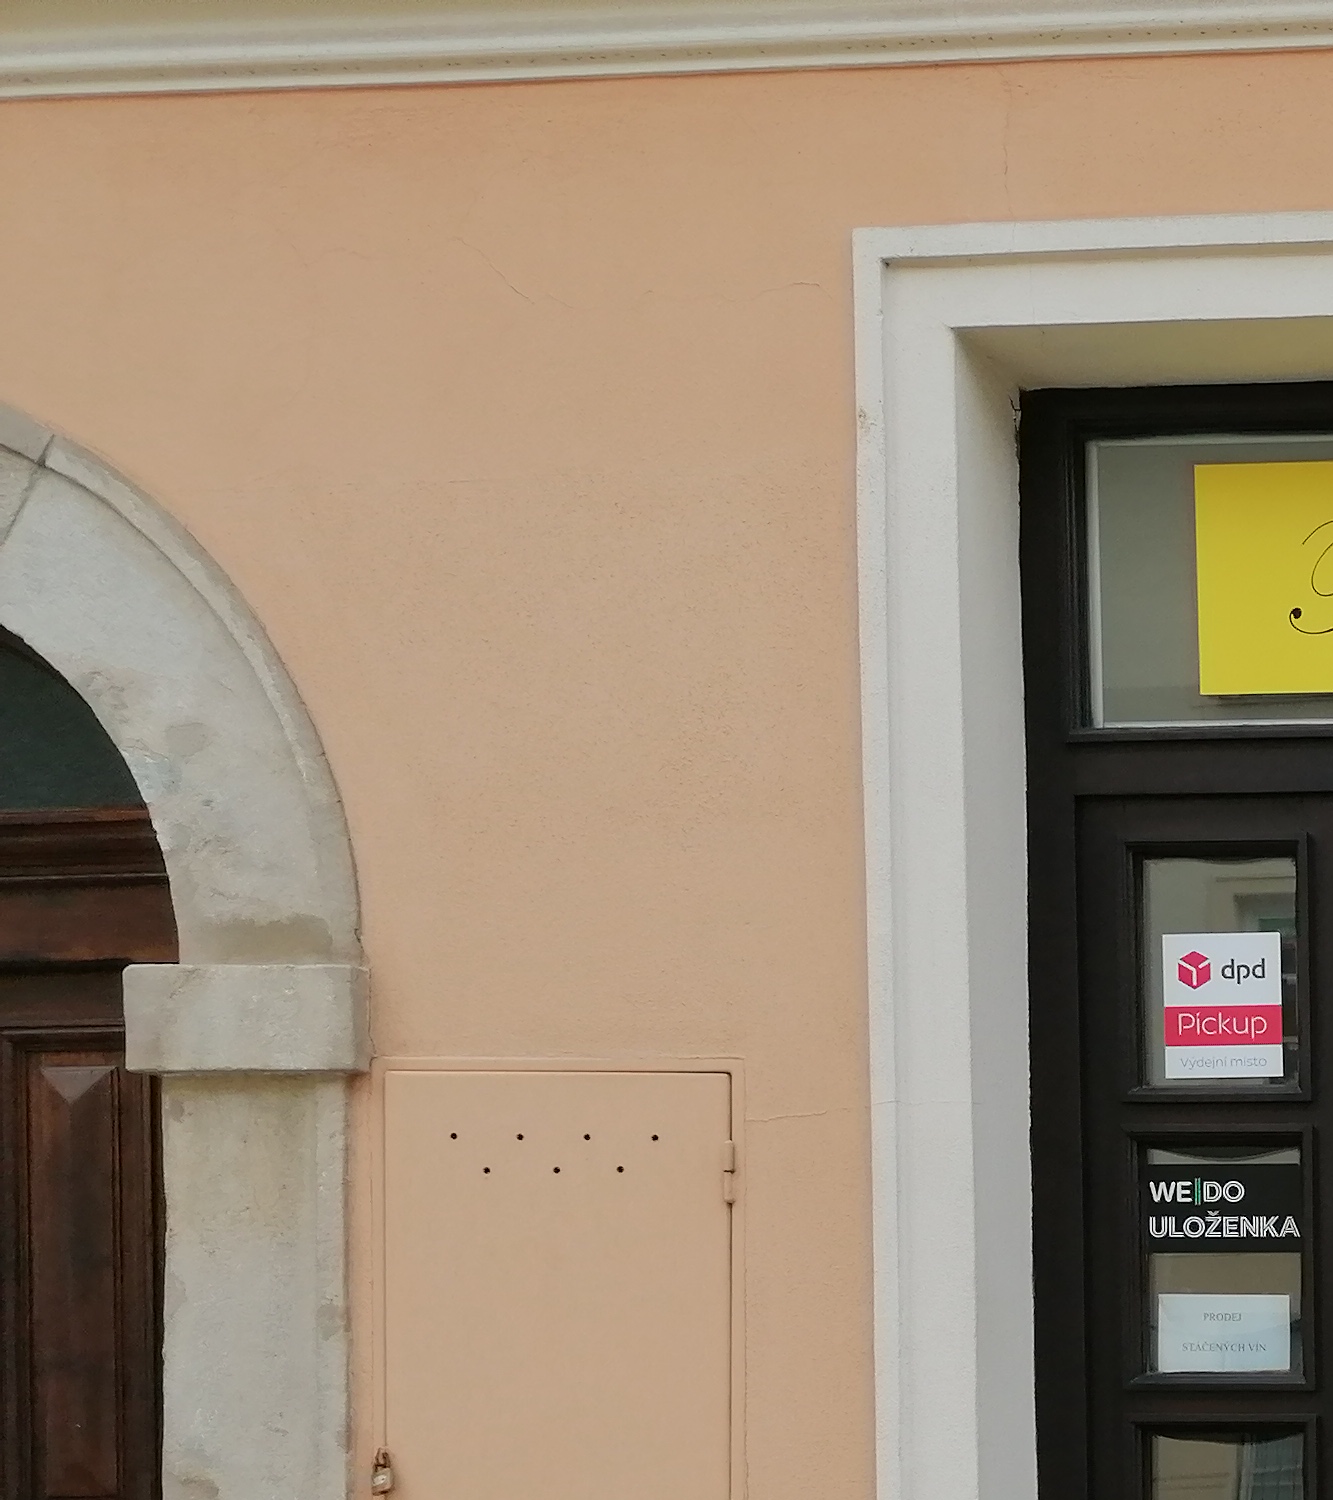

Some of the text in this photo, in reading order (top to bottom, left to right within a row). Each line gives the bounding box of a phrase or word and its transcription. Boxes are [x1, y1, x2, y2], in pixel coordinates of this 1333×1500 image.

[1221, 957, 1267, 987] dpd
[1177, 1009, 1268, 1039] Pickup
[1180, 1055, 1268, 1071] Výdejní místo
[1149, 1209, 1301, 1240] ULOŽENKA
[1202, 1311, 1242, 1323] PRODEJ
[1181, 1337, 1267, 1353] STÁČENÝCH VÍN
